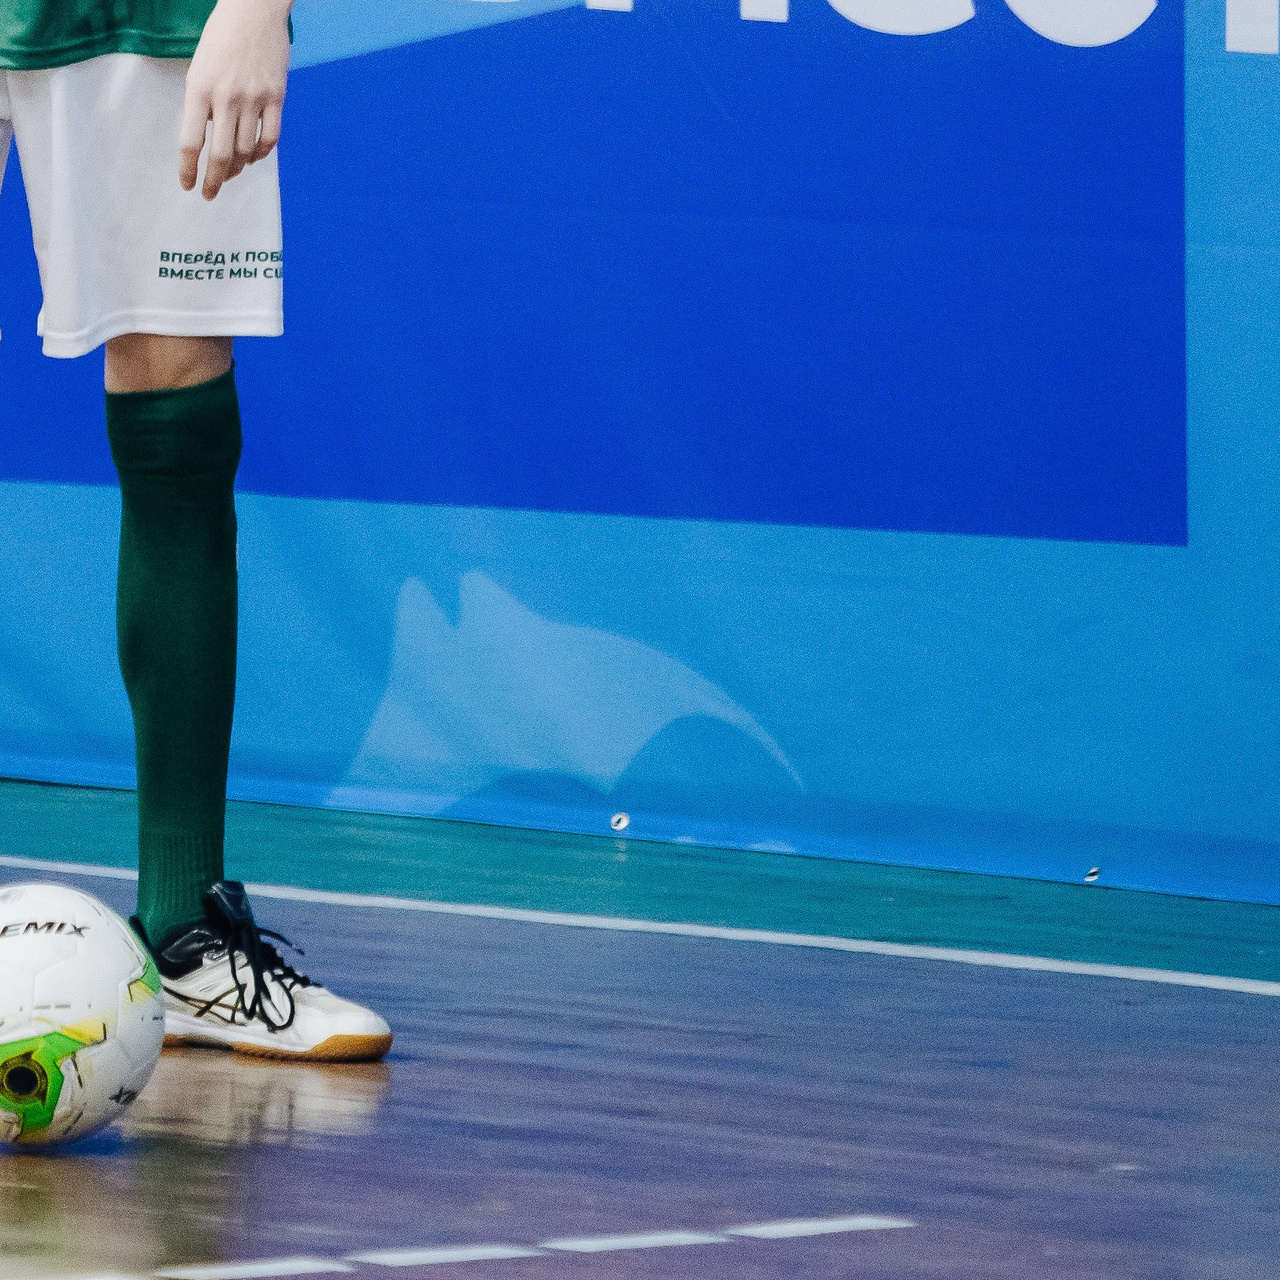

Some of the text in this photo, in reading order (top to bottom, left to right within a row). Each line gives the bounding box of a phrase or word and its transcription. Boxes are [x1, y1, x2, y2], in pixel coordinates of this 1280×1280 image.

[230, 252, 241, 263] К
[158, 267, 224, 280] ВМЕСТЕ
[229, 267, 258, 279] МЫ
